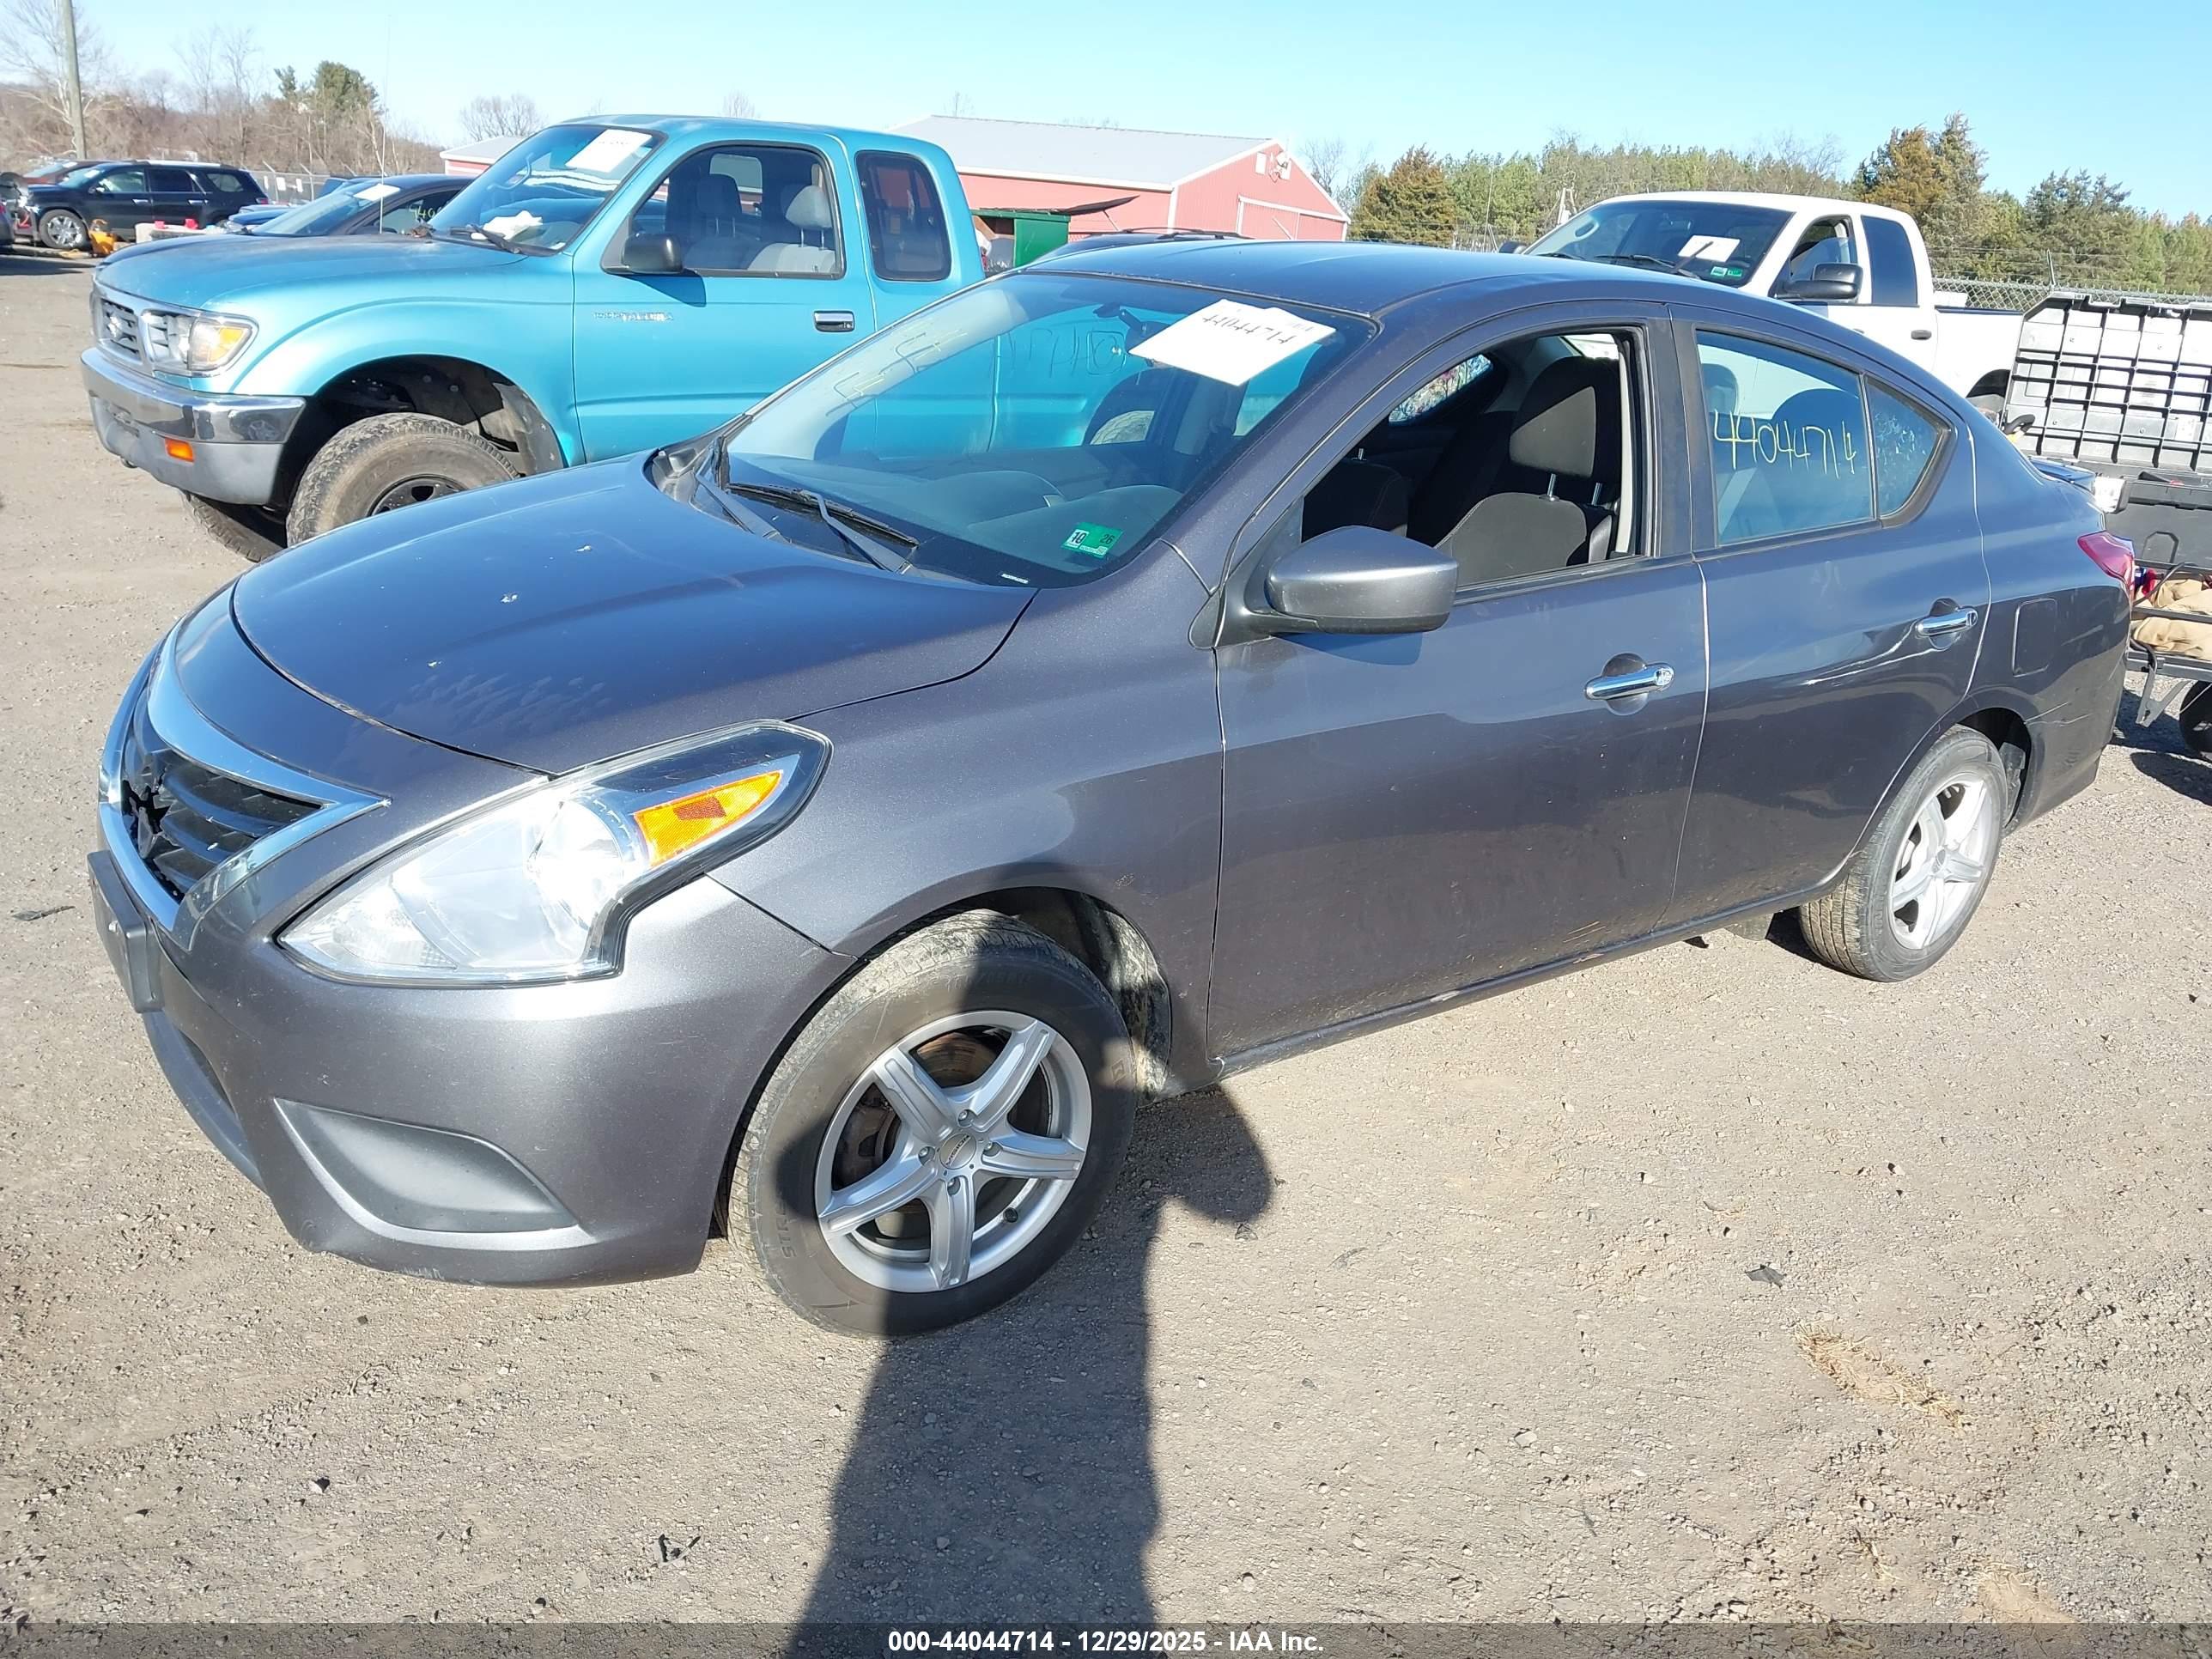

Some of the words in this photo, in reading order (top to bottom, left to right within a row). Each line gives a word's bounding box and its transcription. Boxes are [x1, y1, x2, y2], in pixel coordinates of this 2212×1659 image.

[1202, 313, 1297, 344] 44044714
[1715, 410, 1857, 479] 44044714
[1071, 531, 1087, 544] 10
[1099, 533, 1115, 545] 26
[945, 1133, 971, 1166] VISION
